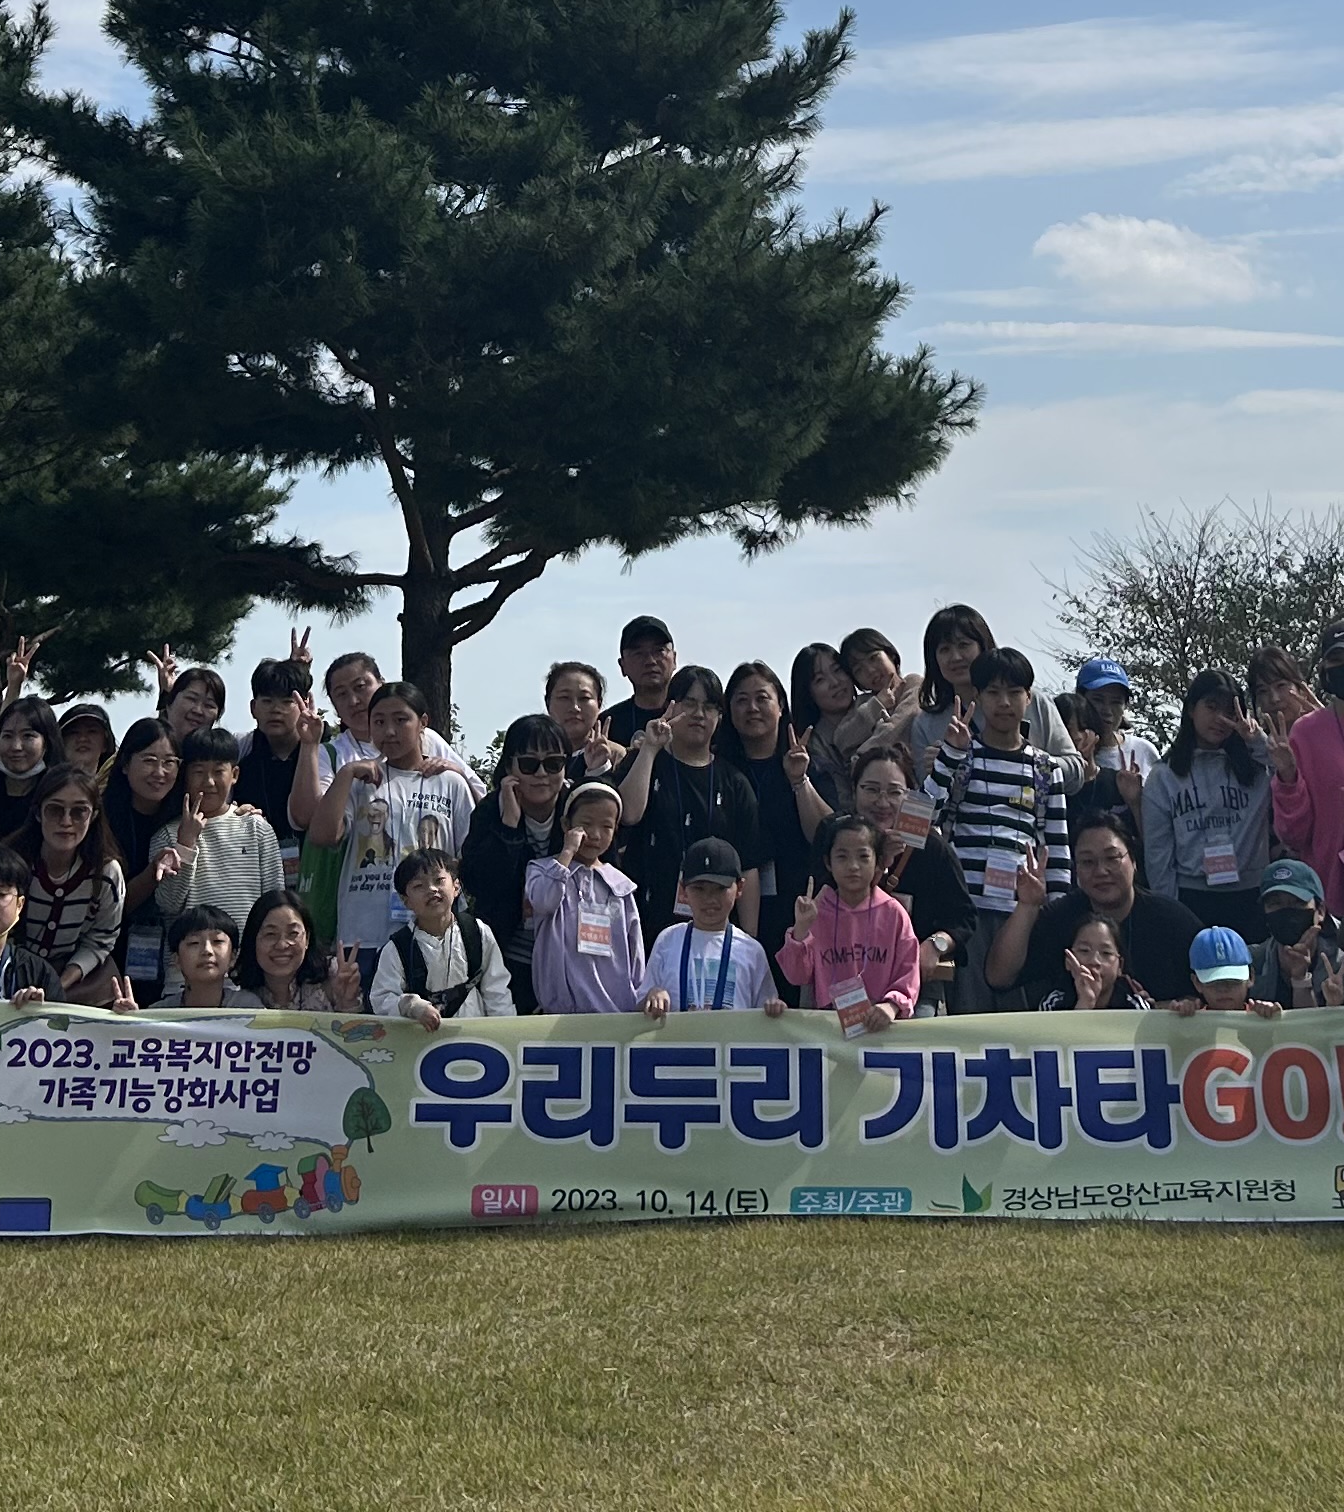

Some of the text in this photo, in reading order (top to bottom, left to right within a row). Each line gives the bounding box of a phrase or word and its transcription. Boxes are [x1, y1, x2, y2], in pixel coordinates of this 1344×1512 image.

[6, 1037, 318, 1075] 2023. 교육복지안전망
[38, 1076, 281, 1113] 가족기능강화사업
[413, 1040, 825, 1150] 우리두리
[480, 1187, 769, 1216] 일시 2023. 10. 14.(토)
[796, 1189, 906, 1213] 주최/주관
[1001, 1178, 1297, 1212] 경상남도양산교육지원청
